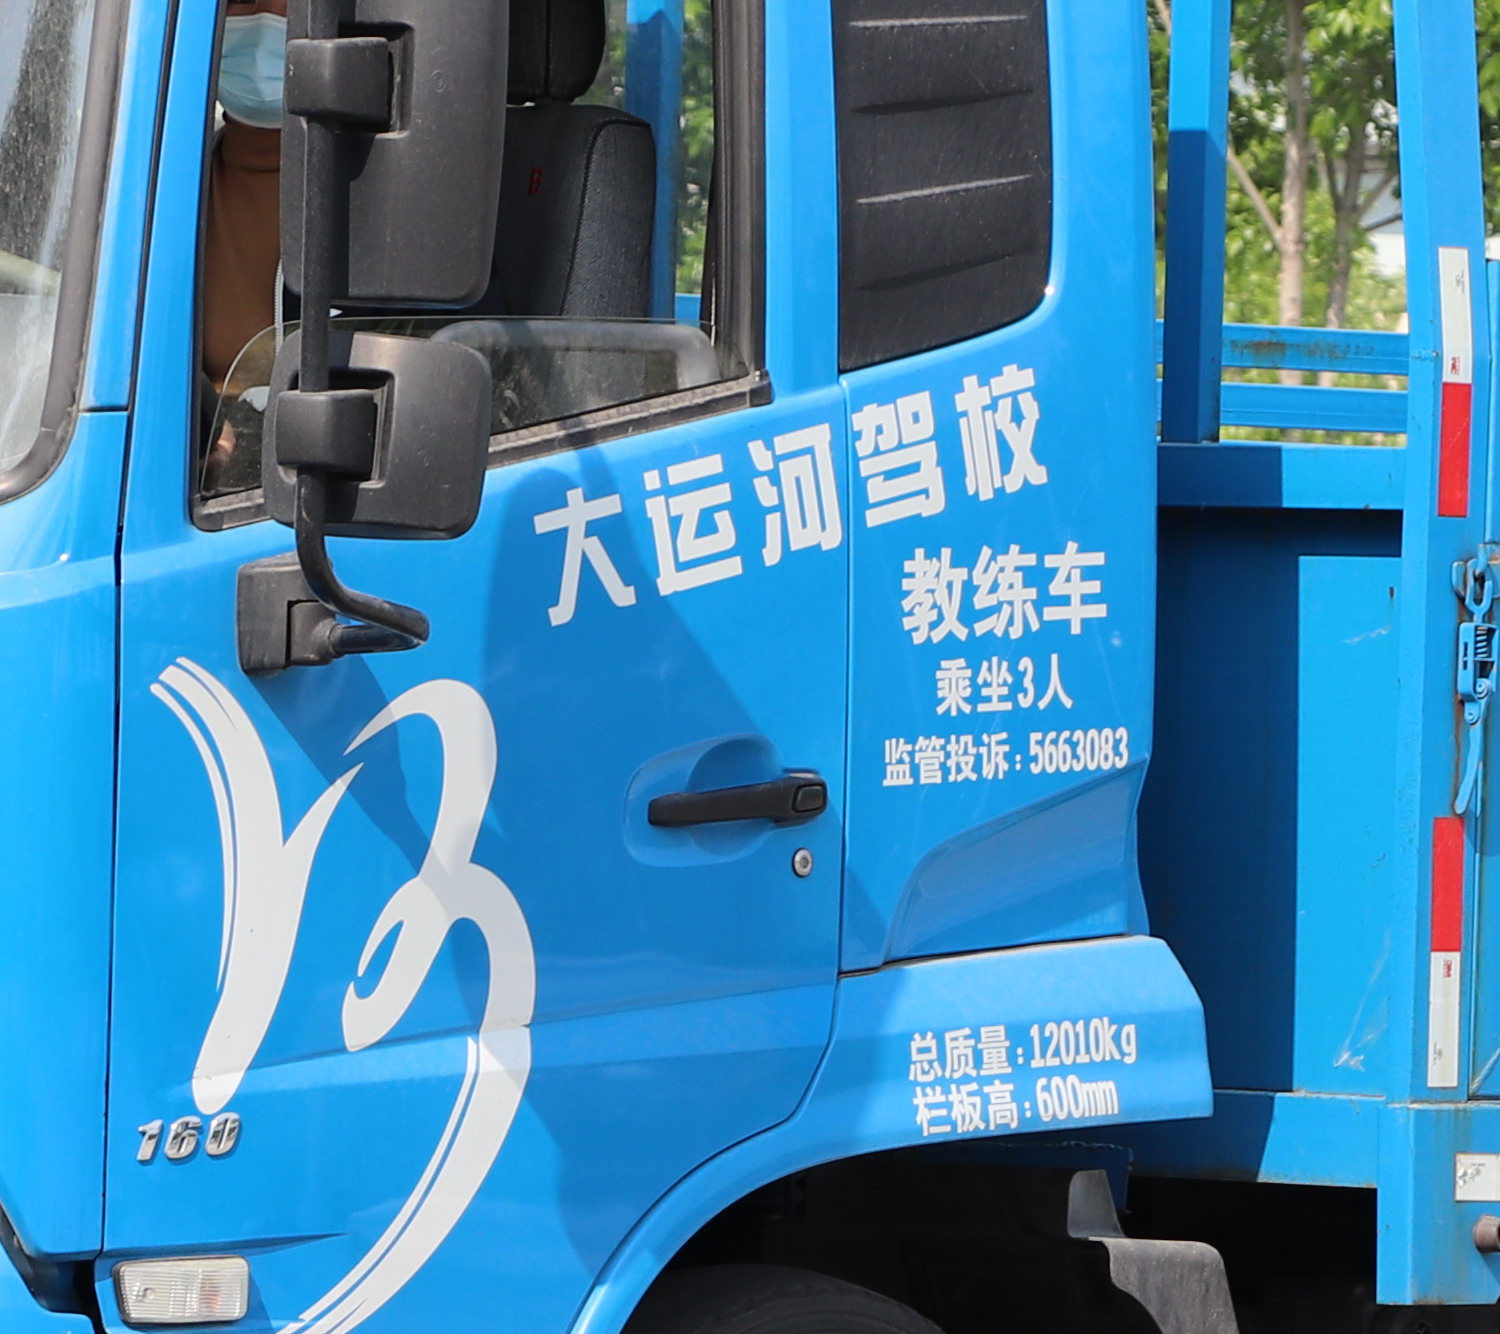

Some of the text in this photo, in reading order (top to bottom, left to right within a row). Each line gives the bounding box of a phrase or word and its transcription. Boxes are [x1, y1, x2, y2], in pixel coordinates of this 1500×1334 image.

[533, 364, 1049, 627] 大运河驾校
[901, 541, 1108, 645] 教练车
[935, 656, 1074, 715] 乘坐3人
[136, 1112, 240, 1161] 160
